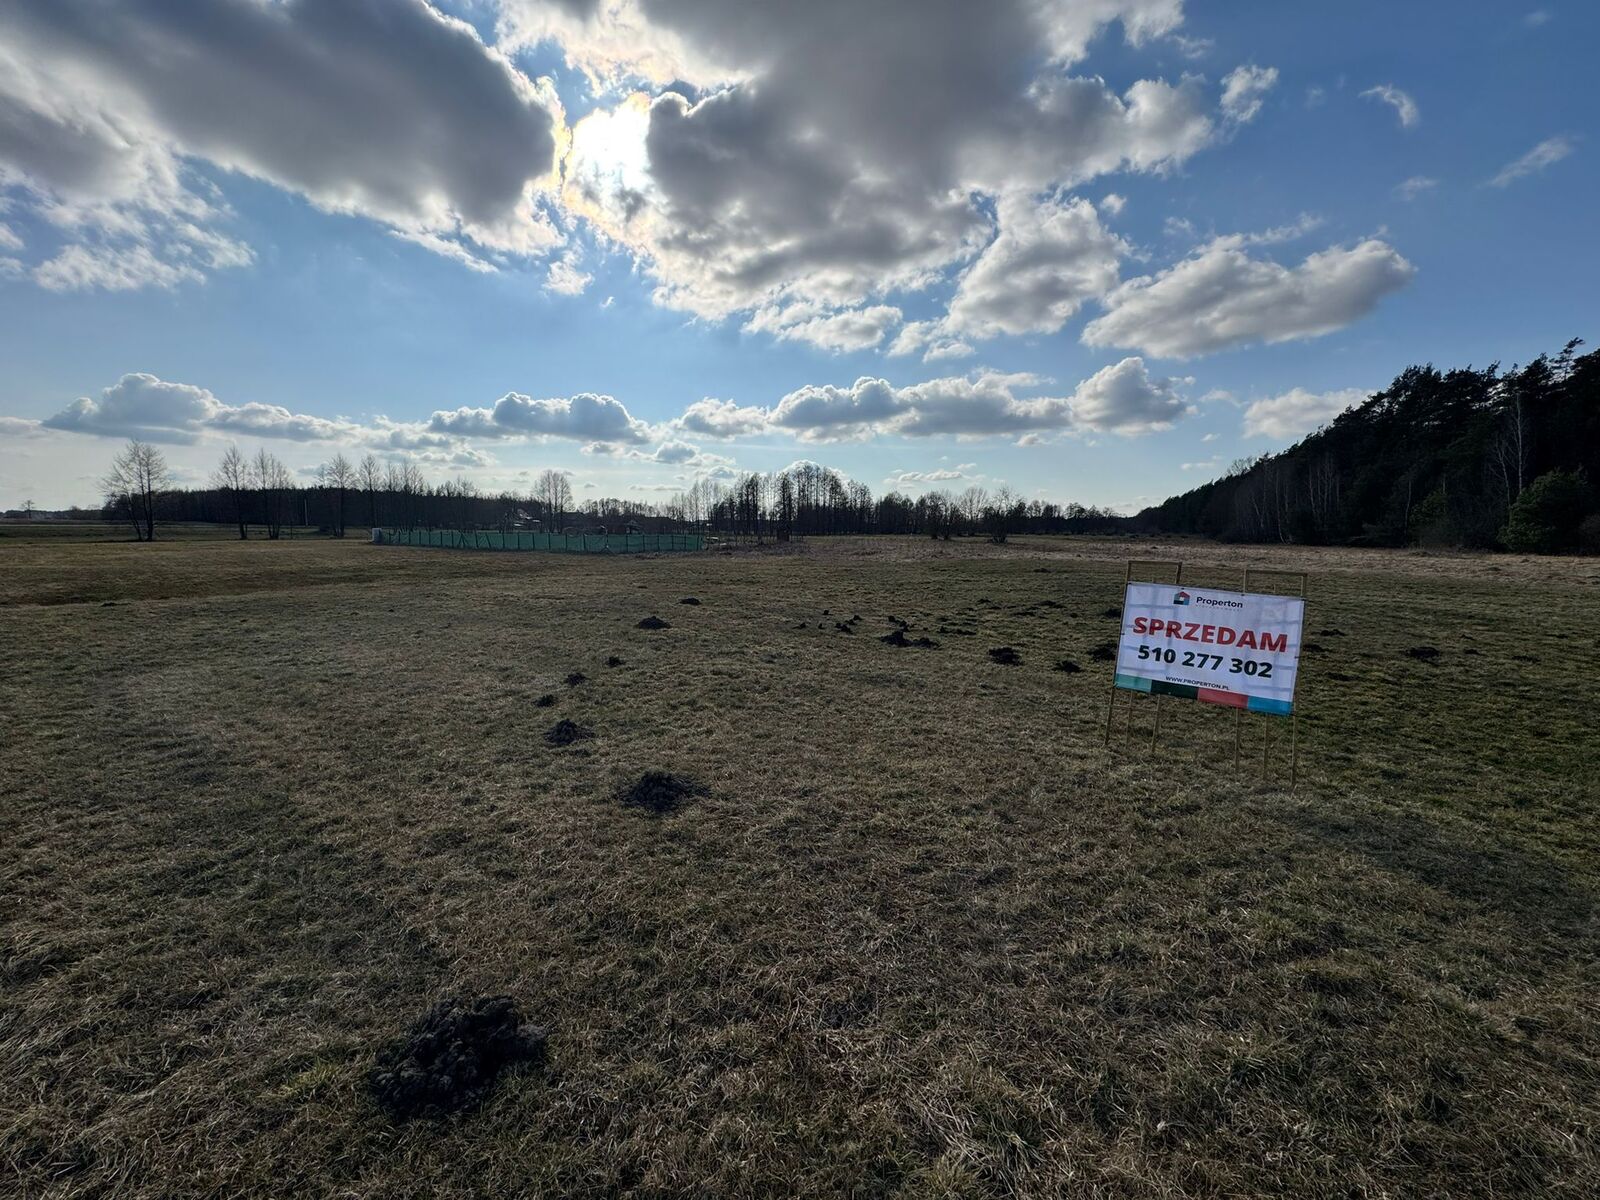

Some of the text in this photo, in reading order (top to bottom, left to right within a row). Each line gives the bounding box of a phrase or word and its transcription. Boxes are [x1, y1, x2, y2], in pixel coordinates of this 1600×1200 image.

[1196, 596, 1243, 608] Properton
[1133, 616, 1288, 653] SPRZEDAM
[1138, 645, 1273, 678] 510 277 302
[1165, 675, 1230, 691] WWW.PROPERTON.PL
